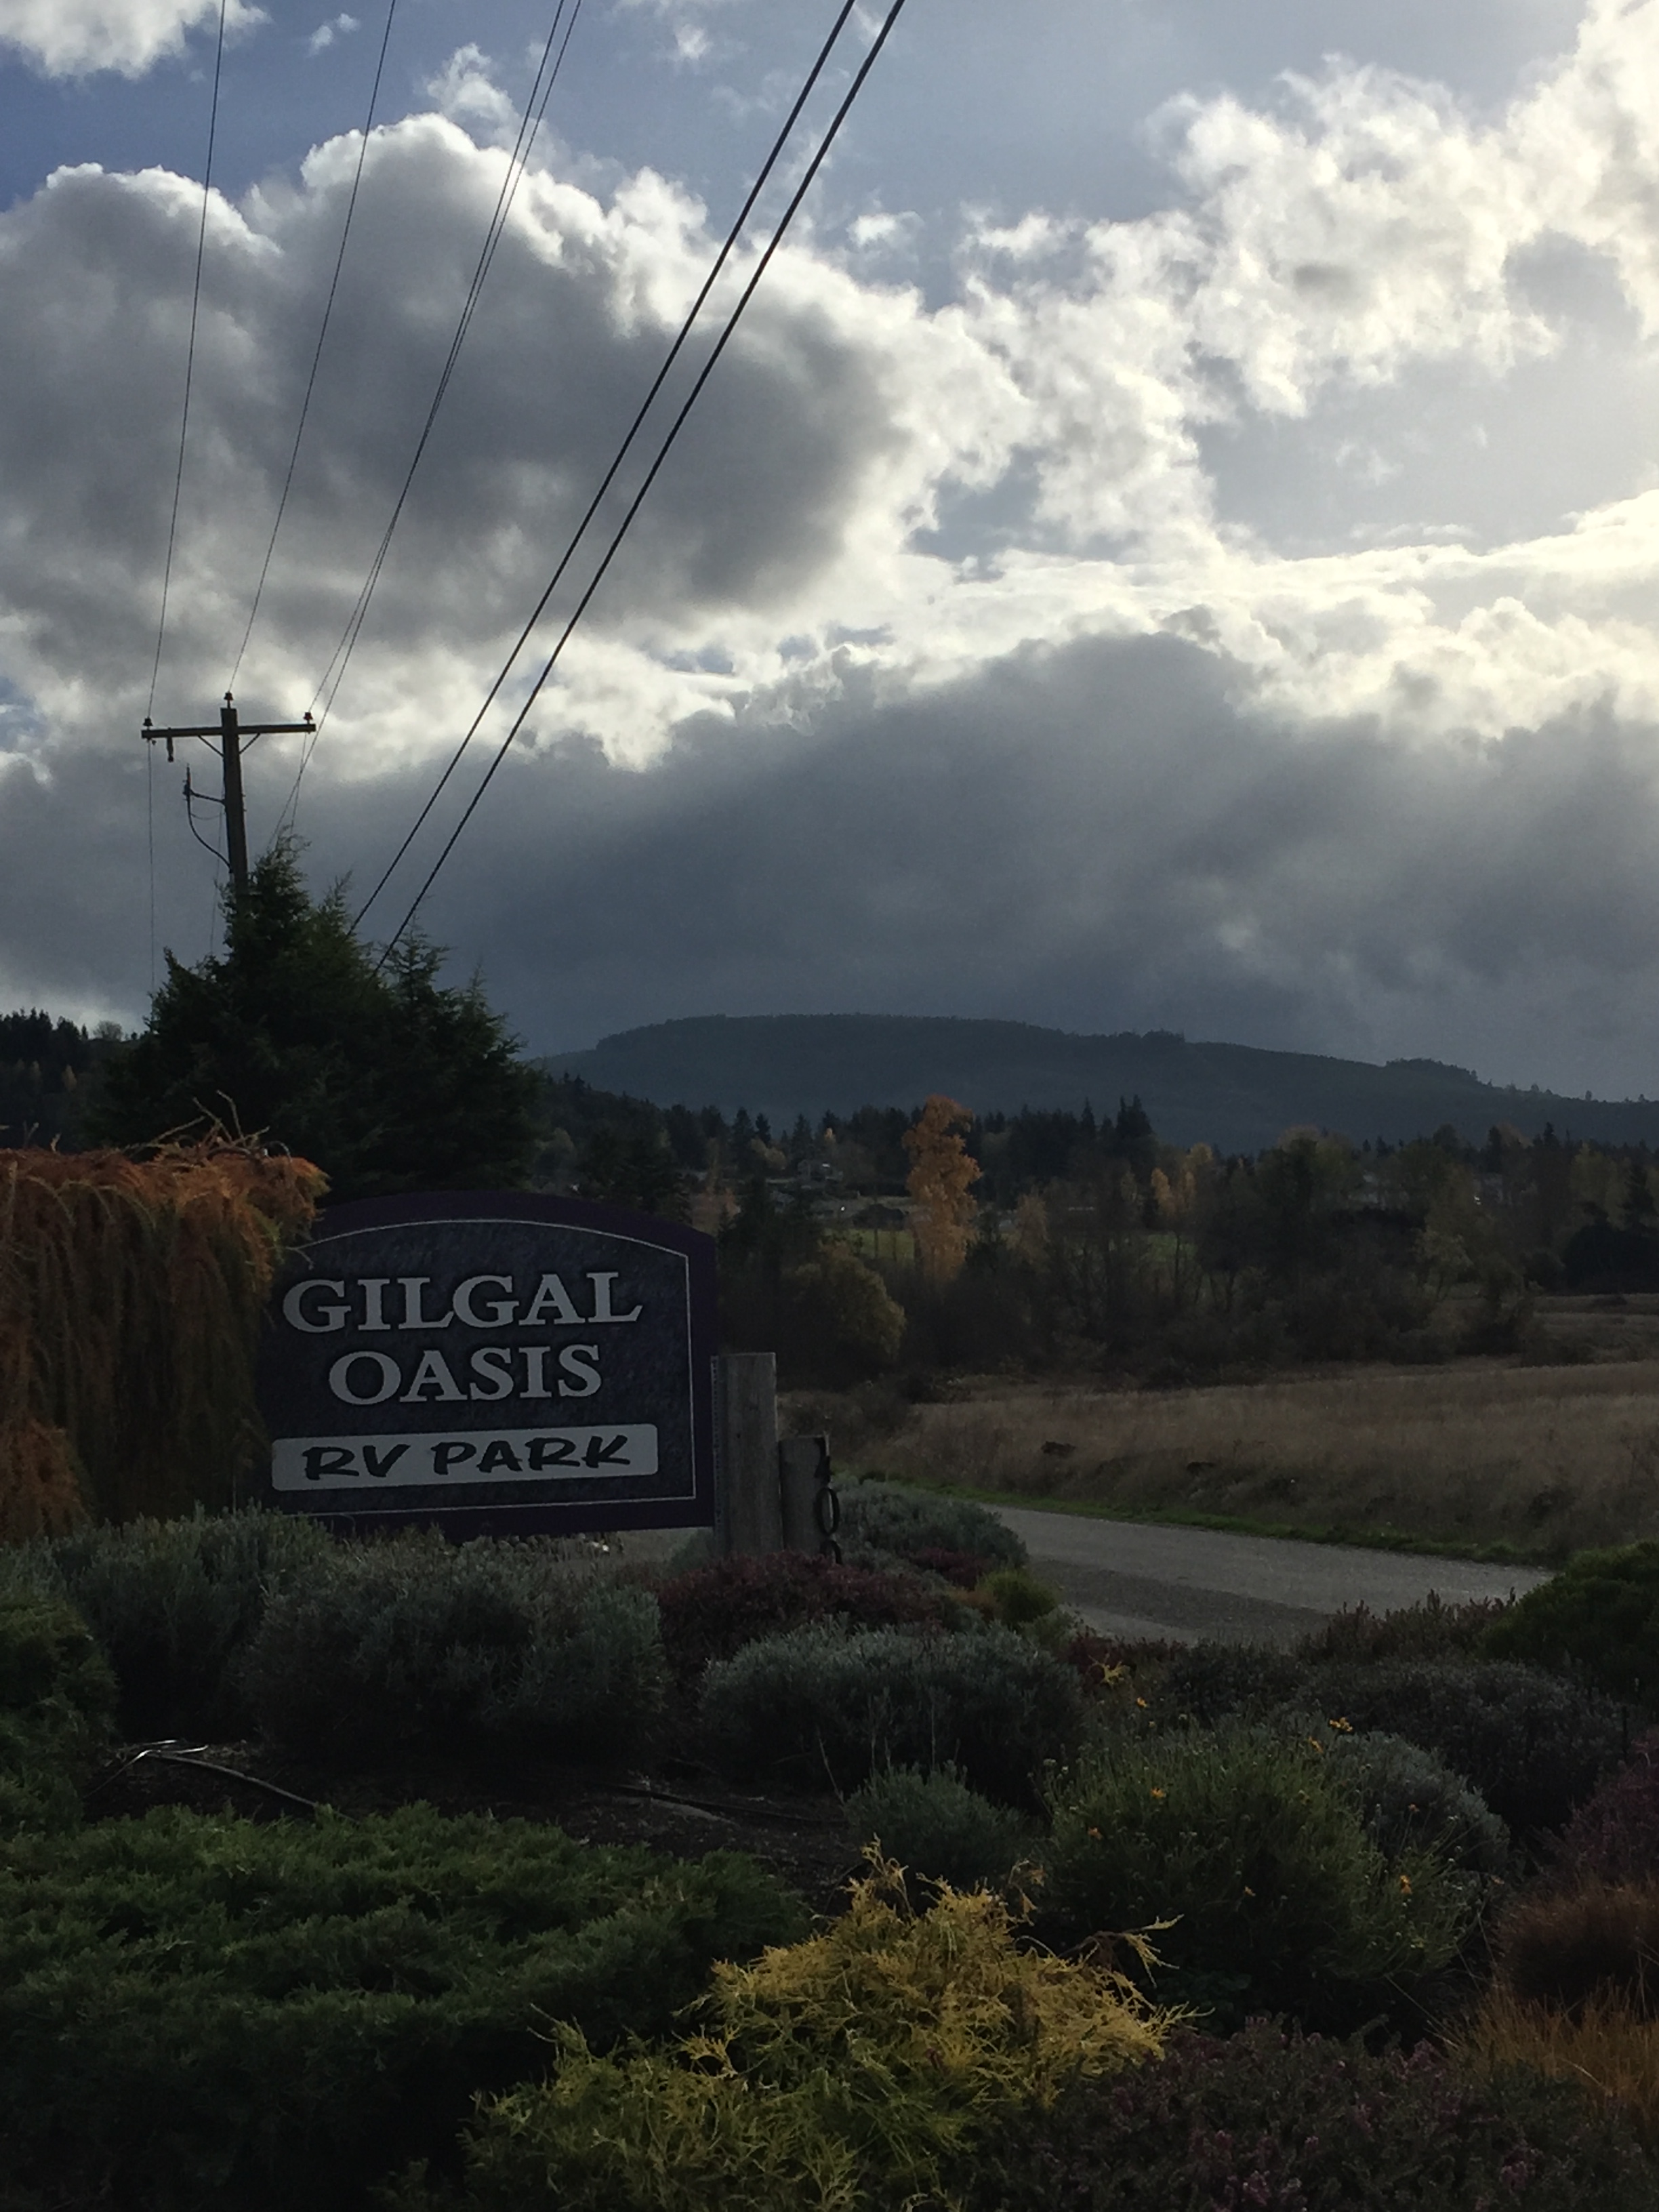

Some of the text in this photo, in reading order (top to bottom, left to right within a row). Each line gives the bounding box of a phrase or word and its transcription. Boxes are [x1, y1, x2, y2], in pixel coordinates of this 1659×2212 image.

[282, 1272, 643, 1333] GILGAL
[328, 1344, 602, 1406] OASIS
[302, 1434, 632, 1481] RV PARK
